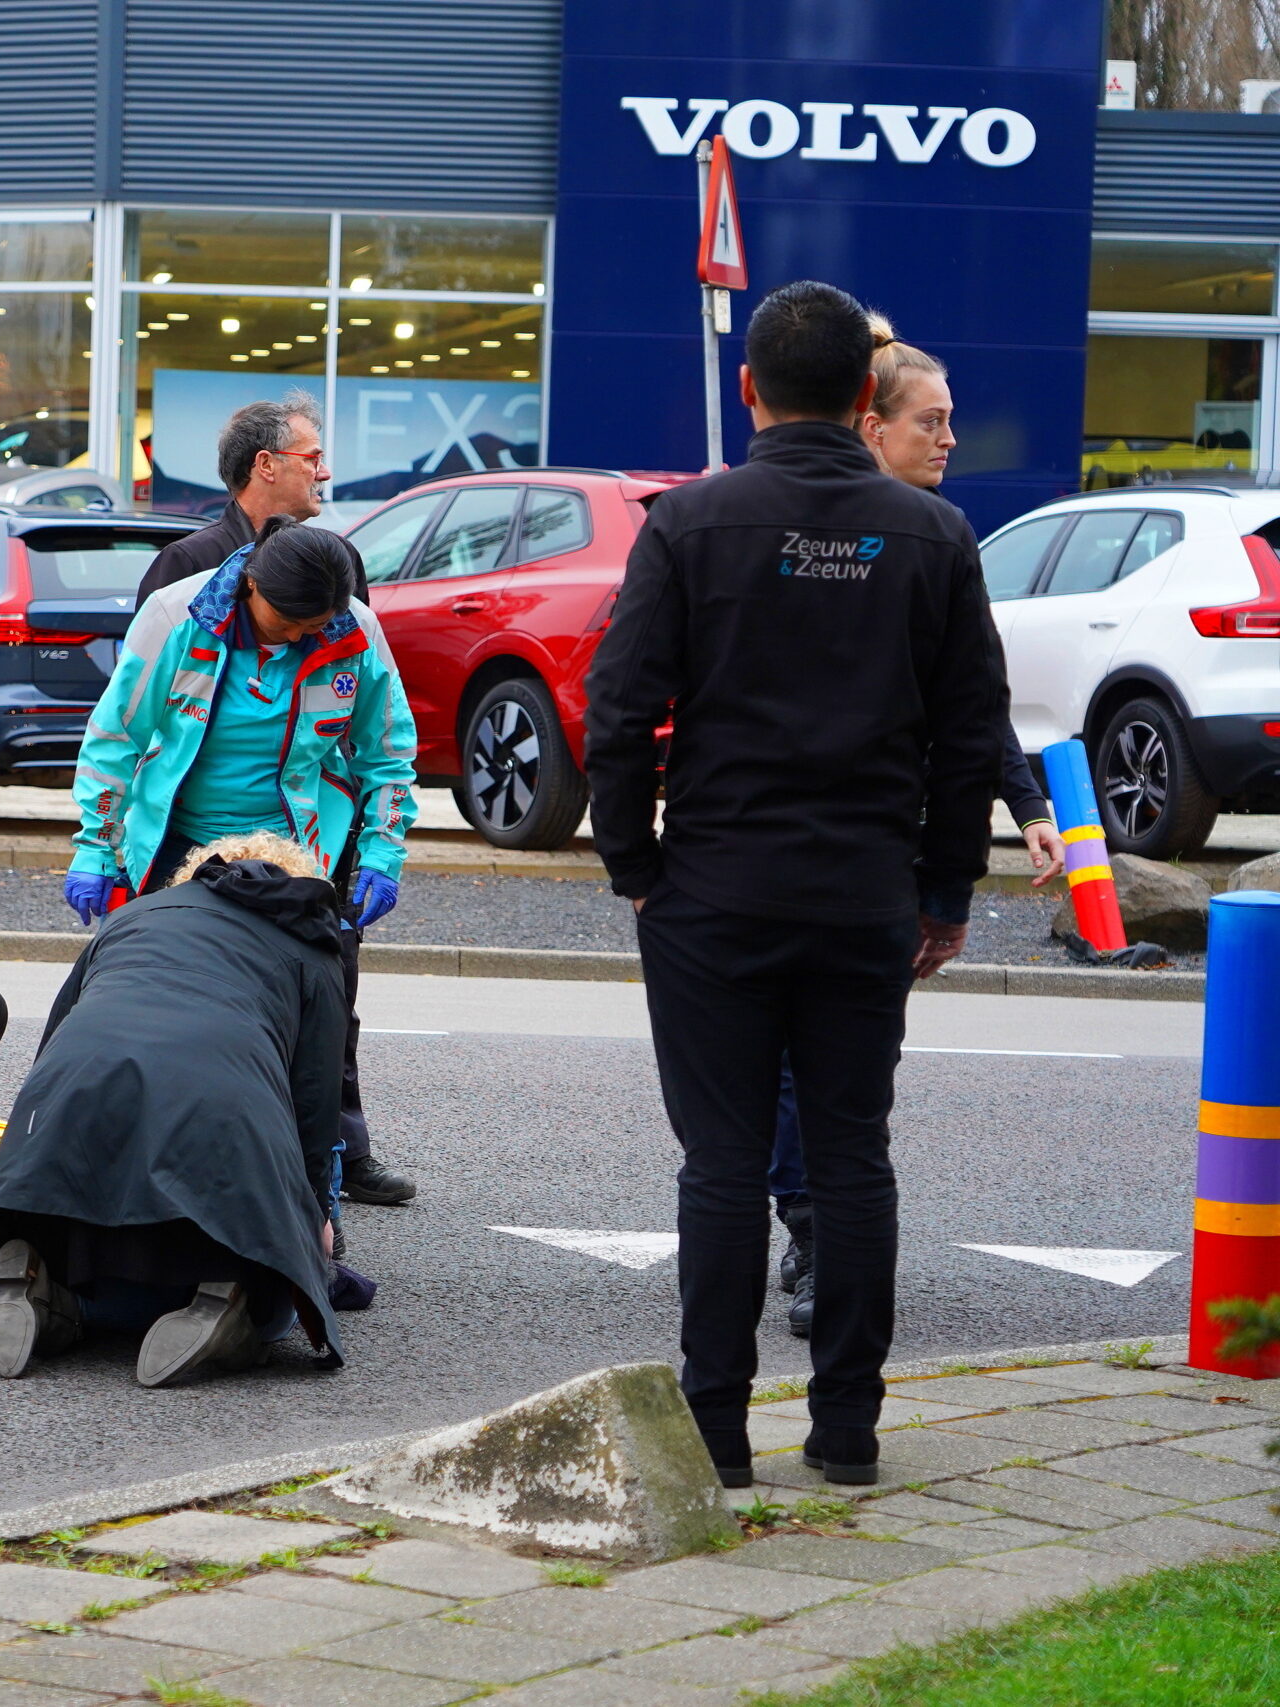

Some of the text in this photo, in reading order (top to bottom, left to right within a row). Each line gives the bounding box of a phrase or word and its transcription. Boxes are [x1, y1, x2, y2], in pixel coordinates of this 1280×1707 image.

[621, 96, 1036, 167] VOLVO
[781, 532, 858, 558] Zeeuw
[38, 649, 70, 660] V60
